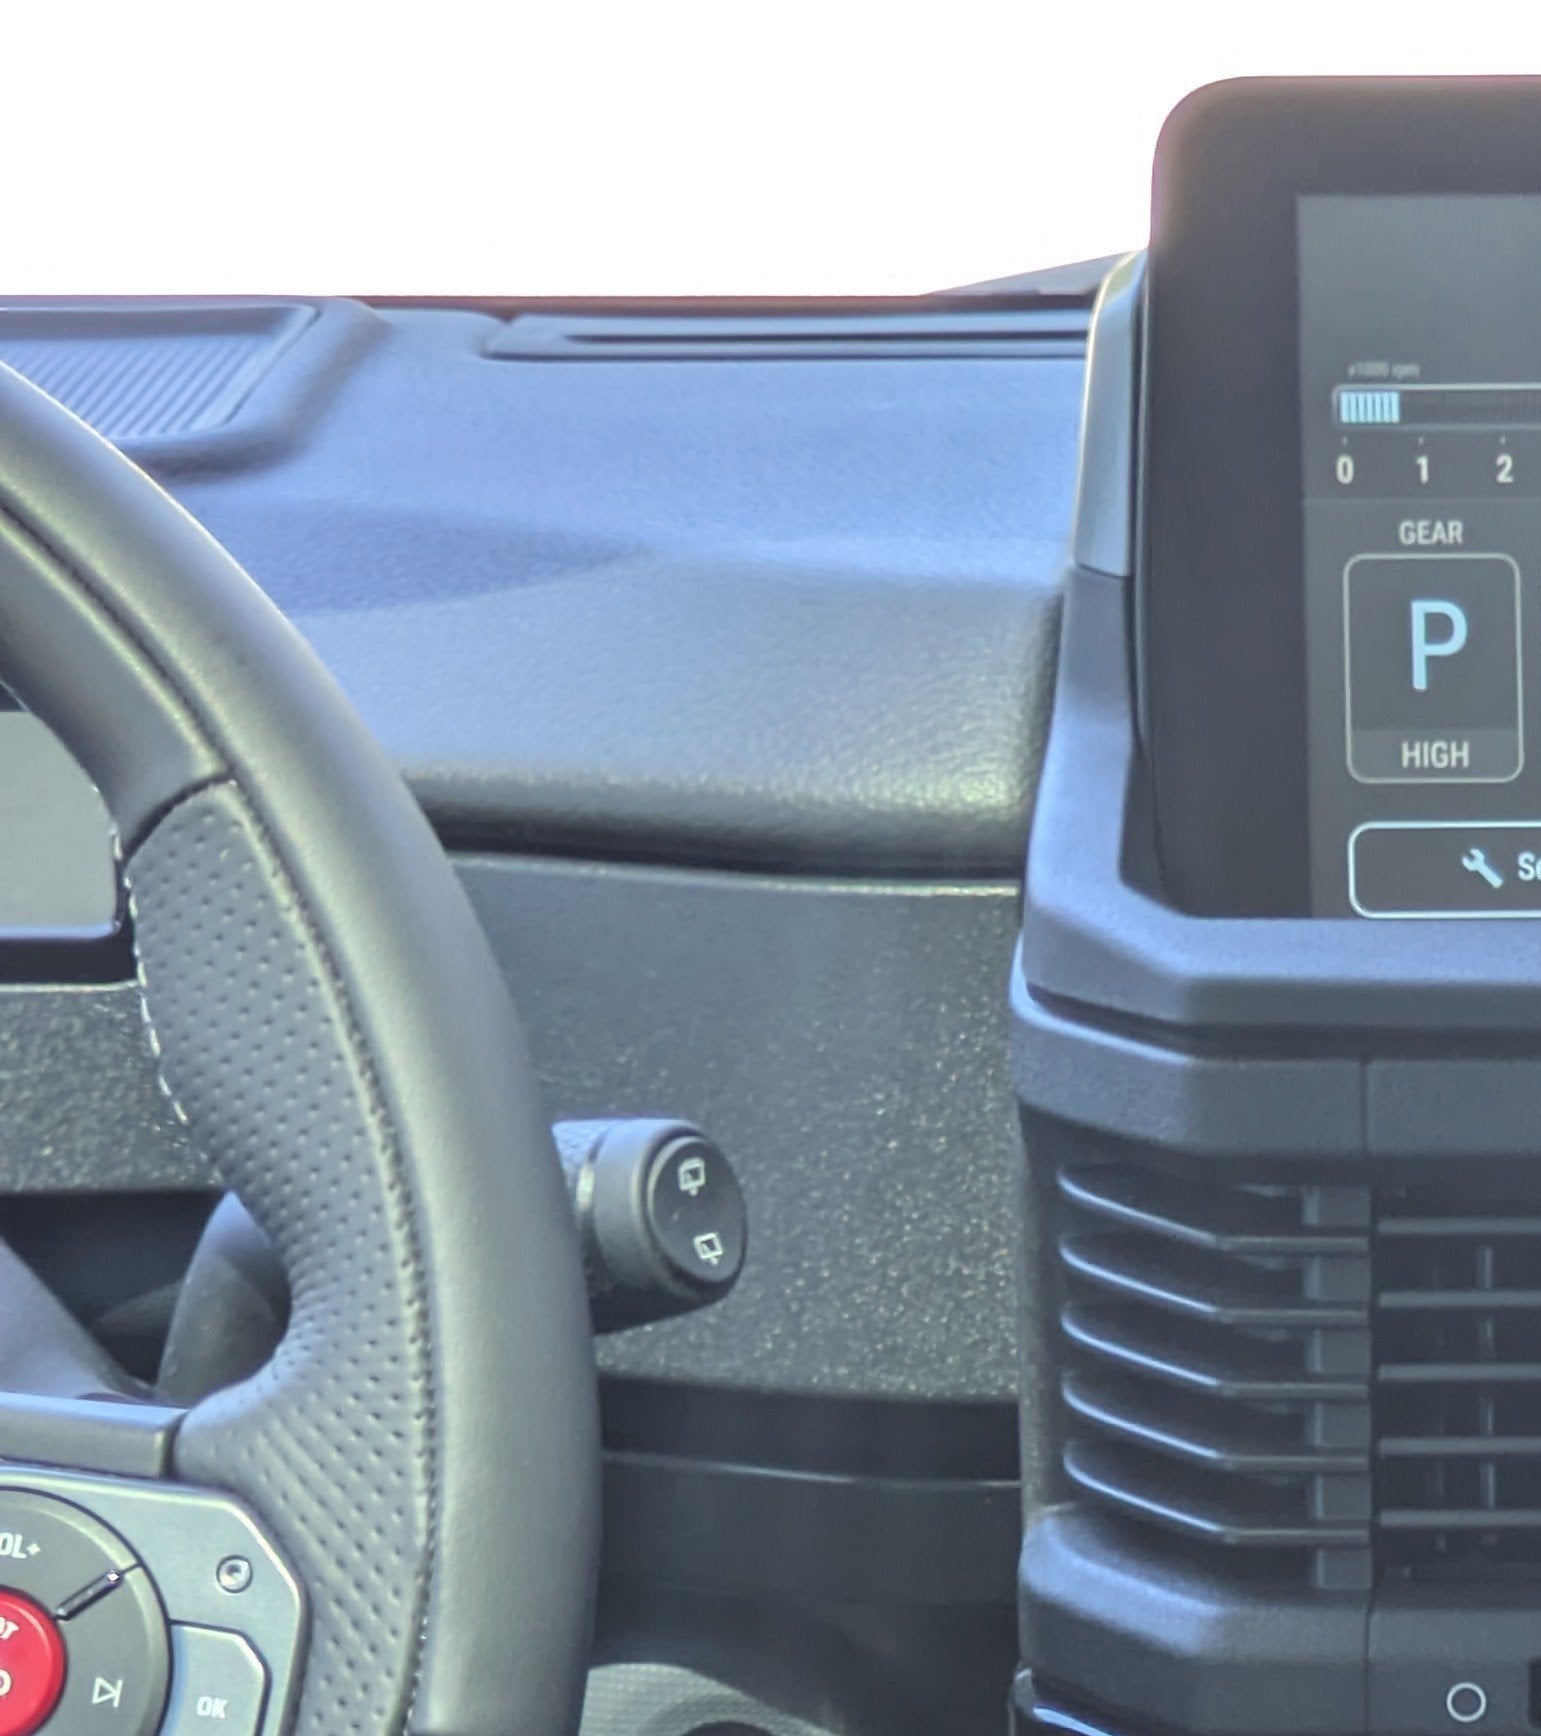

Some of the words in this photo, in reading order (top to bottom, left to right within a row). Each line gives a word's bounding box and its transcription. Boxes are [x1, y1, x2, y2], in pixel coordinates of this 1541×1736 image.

[1336, 454, 1354, 484] 0
[1416, 455, 1429, 483] 1
[1496, 453, 1514, 483] 2
[1398, 519, 1464, 545] GEAR
[1410, 599, 1468, 691] P
[1401, 740, 1470, 769] HIGH
[196, 1696, 229, 1720] OK
